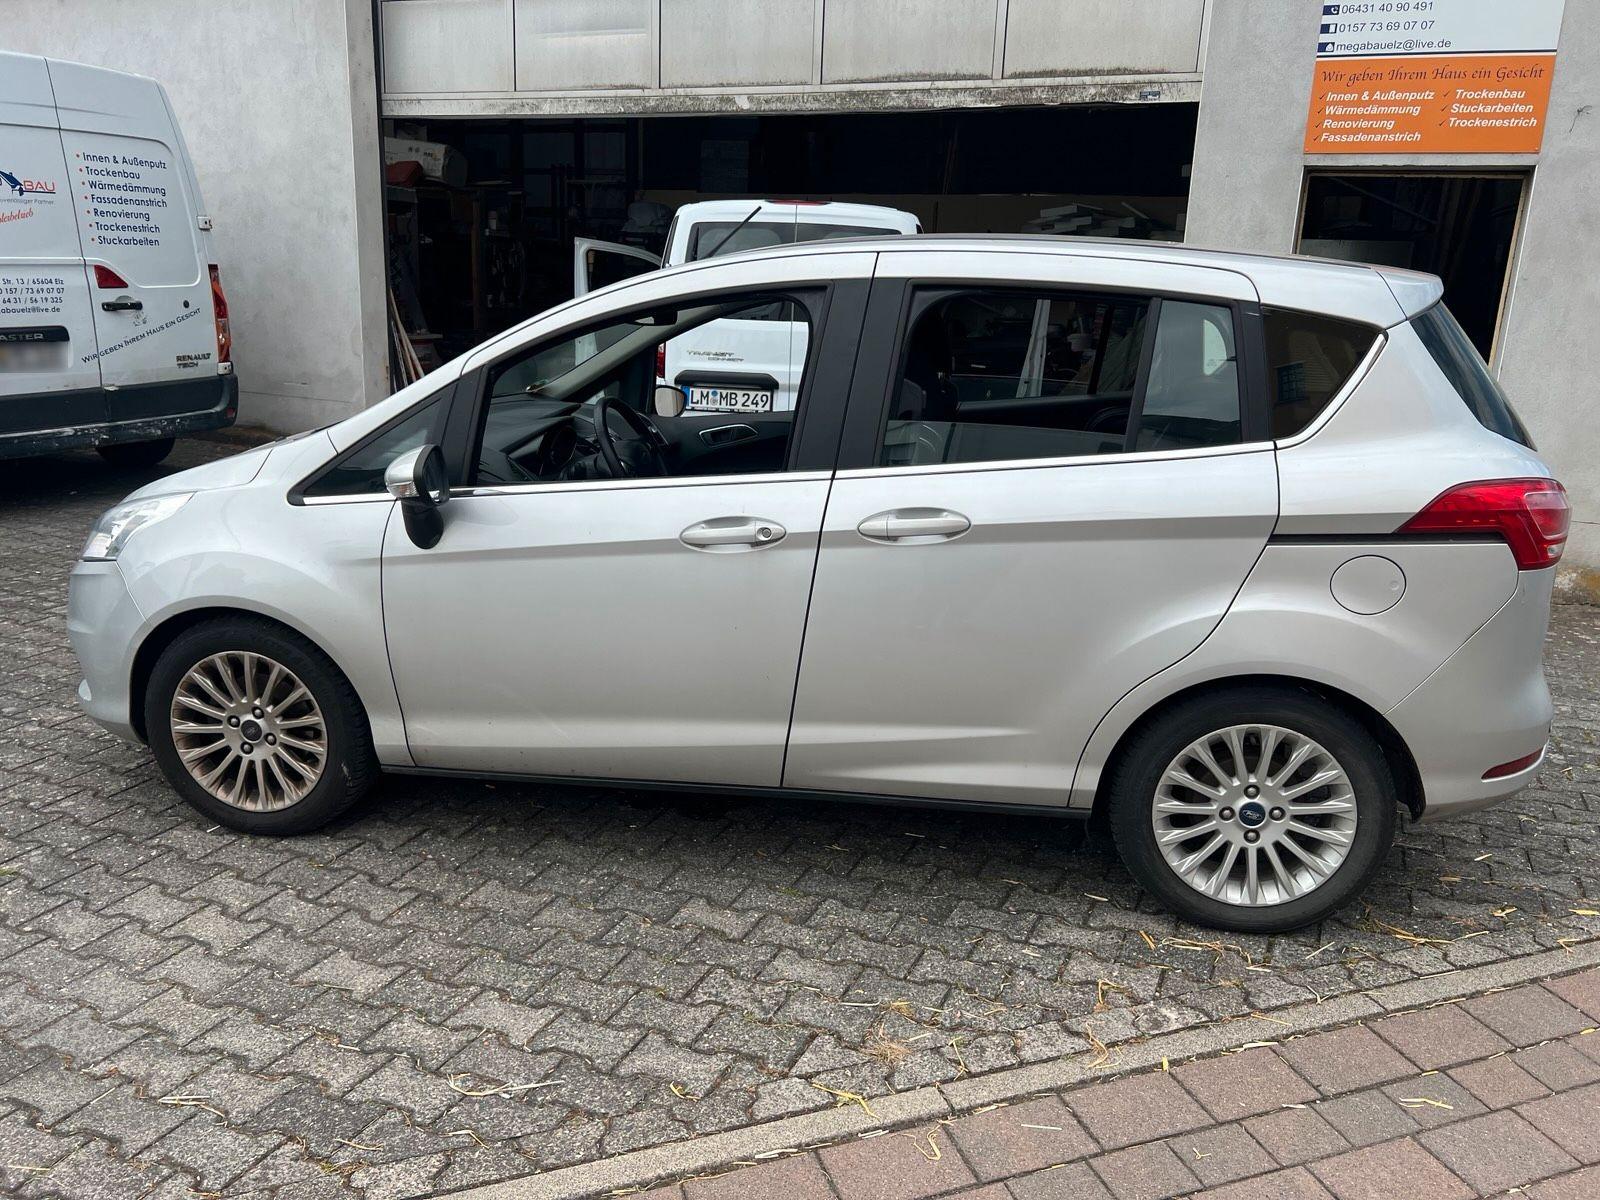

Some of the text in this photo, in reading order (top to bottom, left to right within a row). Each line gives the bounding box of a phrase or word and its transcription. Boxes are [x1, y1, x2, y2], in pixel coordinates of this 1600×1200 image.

[1341, 1, 1433, 14] 06431 40 90 491
[1339, 20, 1435, 33] 0157 73 69 07 07
[1336, 38, 1452, 52] megabauelz@live.de
[1322, 63, 1544, 87] Wir geben Ihrem Haus ein Gesicht
[1326, 90, 1435, 102] Innen & Außenputz
[1455, 88, 1525, 99] Trockenbau
[1325, 104, 1421, 116] Wärmedämmung
[1450, 103, 1533, 113] Stuckarbeiten
[1322, 119, 1395, 129] Renovierung
[1449, 117, 1537, 128] Trockenestrich
[1320, 131, 1421, 142] Fassadenanstrich
[83, 152, 167, 169] Innen & Außenputz
[85, 166, 140, 179] Trockenbau
[24, 180, 55, 192] BAU
[88, 180, 166, 197] Wärmedämmung
[91, 194, 168, 207] Fassadenanstrich
[93, 208, 150, 221] Renovierung
[95, 221, 160, 233] Trockenestrich
[97, 235, 160, 246] Stuckarbeiten
[0, 306, 61, 314] abauelz@live.de
[0, 333, 44, 341] ASTER
[690, 389, 769, 409] LM MB 249
